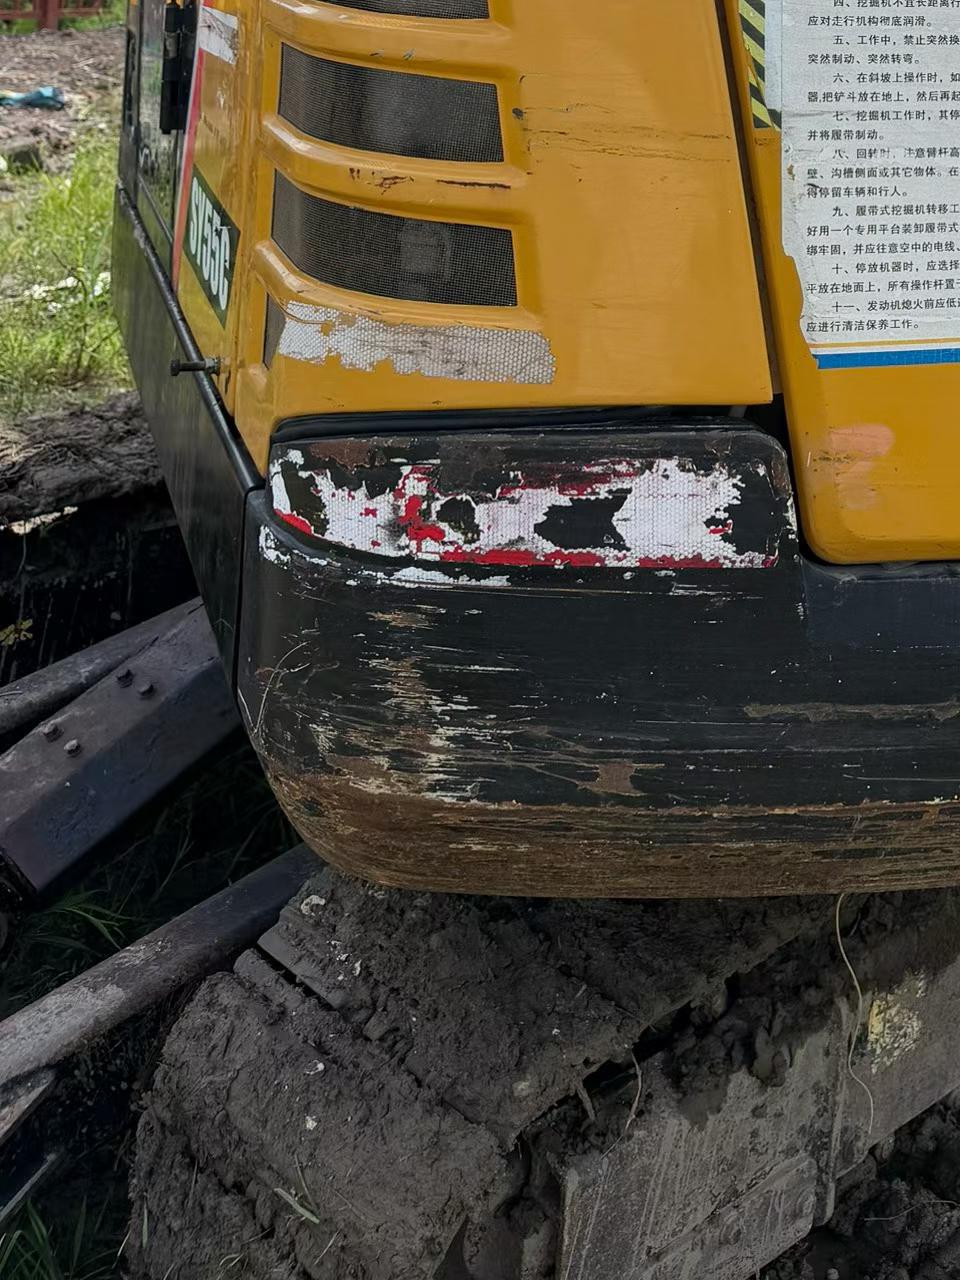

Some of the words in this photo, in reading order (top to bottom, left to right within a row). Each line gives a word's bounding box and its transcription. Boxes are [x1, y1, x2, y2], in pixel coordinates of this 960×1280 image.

[807, 15, 932, 28] 应对走行机构彻底润滑。
[808, 53, 920, 65] 突然制动、突然转弯。
[807, 128, 884, 141] 并将履带制动。
[806, 185, 908, 199] 得停留车辆和行人。
[188, 176, 231, 312] SY55C
[806, 319, 919, 333] 应进行清洁保养工作。
